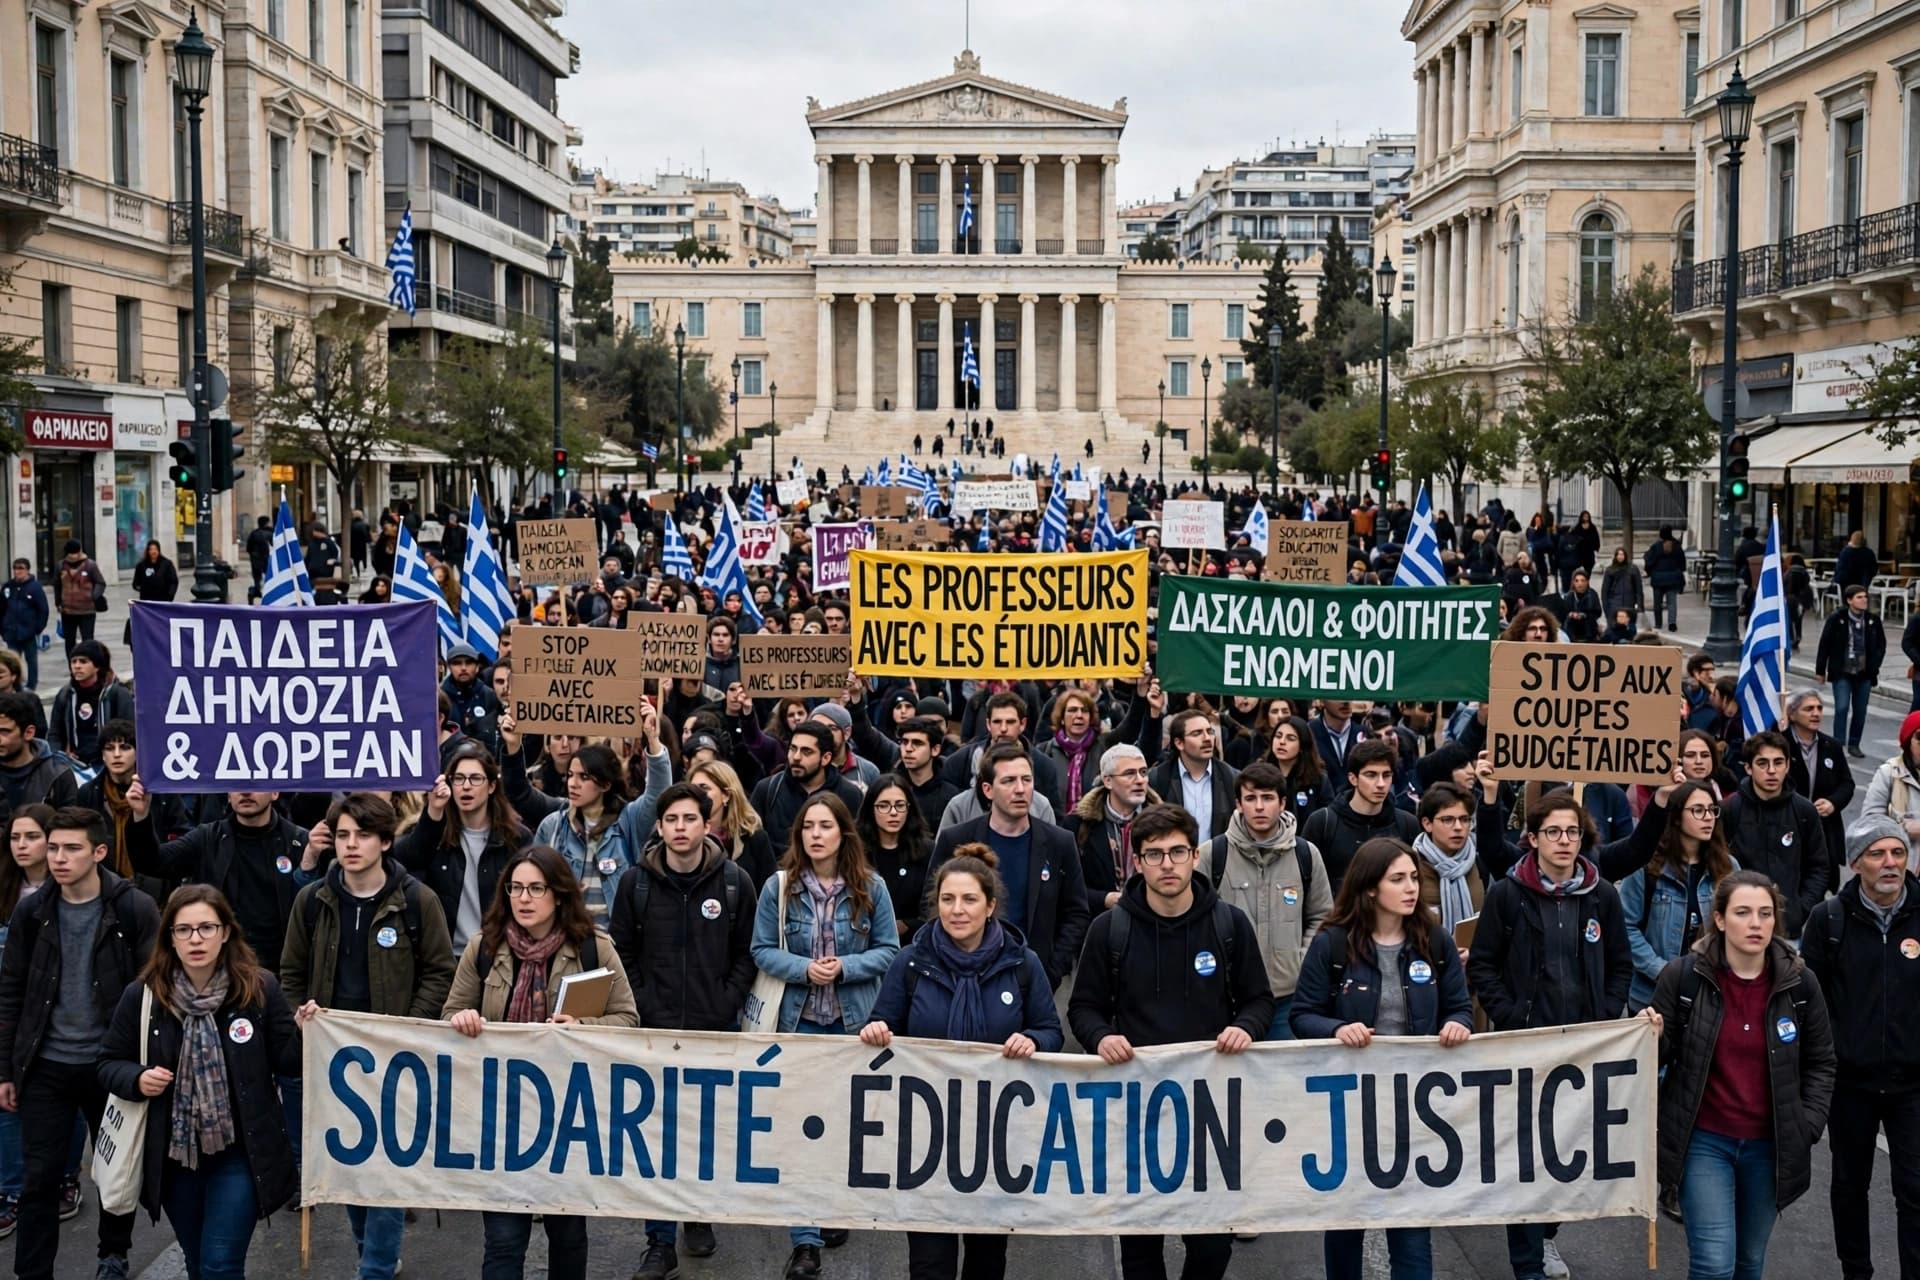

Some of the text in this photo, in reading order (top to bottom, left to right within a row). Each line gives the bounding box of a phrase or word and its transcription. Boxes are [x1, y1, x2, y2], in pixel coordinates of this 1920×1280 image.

[33, 416, 108, 441] ΦΑΡΜΑΚΕΙΟ
[520, 523, 567, 538] ΠΑΙΔΕΙΑ
[859, 560, 912, 608] LES
[923, 563, 1135, 612] PROFESSEURS
[1168, 590, 1492, 641] ΔΑΣΚΑΛΟΙ & ΦΟΙΤΗΤΕΣ
[169, 618, 398, 668] ΠΑΙΔΕΙΑ
[542, 635, 590, 655] STOP
[743, 647, 847, 664] LES PROFESSEURS
[857, 613, 1140, 668] AVEC LES ÉTUDIANTS
[548, 679, 594, 698] AVEC
[582, 658, 617, 677] AUX
[748, 673, 775, 691] AVEC
[779, 673, 799, 690] LES
[1223, 643, 1395, 691] ΕΝΩΜΕΝΟΙ
[1520, 652, 1673, 695] STOP AUX
[165, 675, 404, 724] ΔΗΜΟΖΙΑ
[516, 700, 636, 725] BUDGÉTAIRES
[1513, 696, 1629, 730] COUPES
[162, 729, 423, 781] & ΔΩΡΕΑΝ
[1493, 728, 1672, 775] BUDGÉTAIRES
[324, 1043, 782, 1184] SOLIDARITÉ
[847, 1048, 1242, 1195] ÉDUCATION
[1302, 1058, 1639, 1193] JUSTICE
